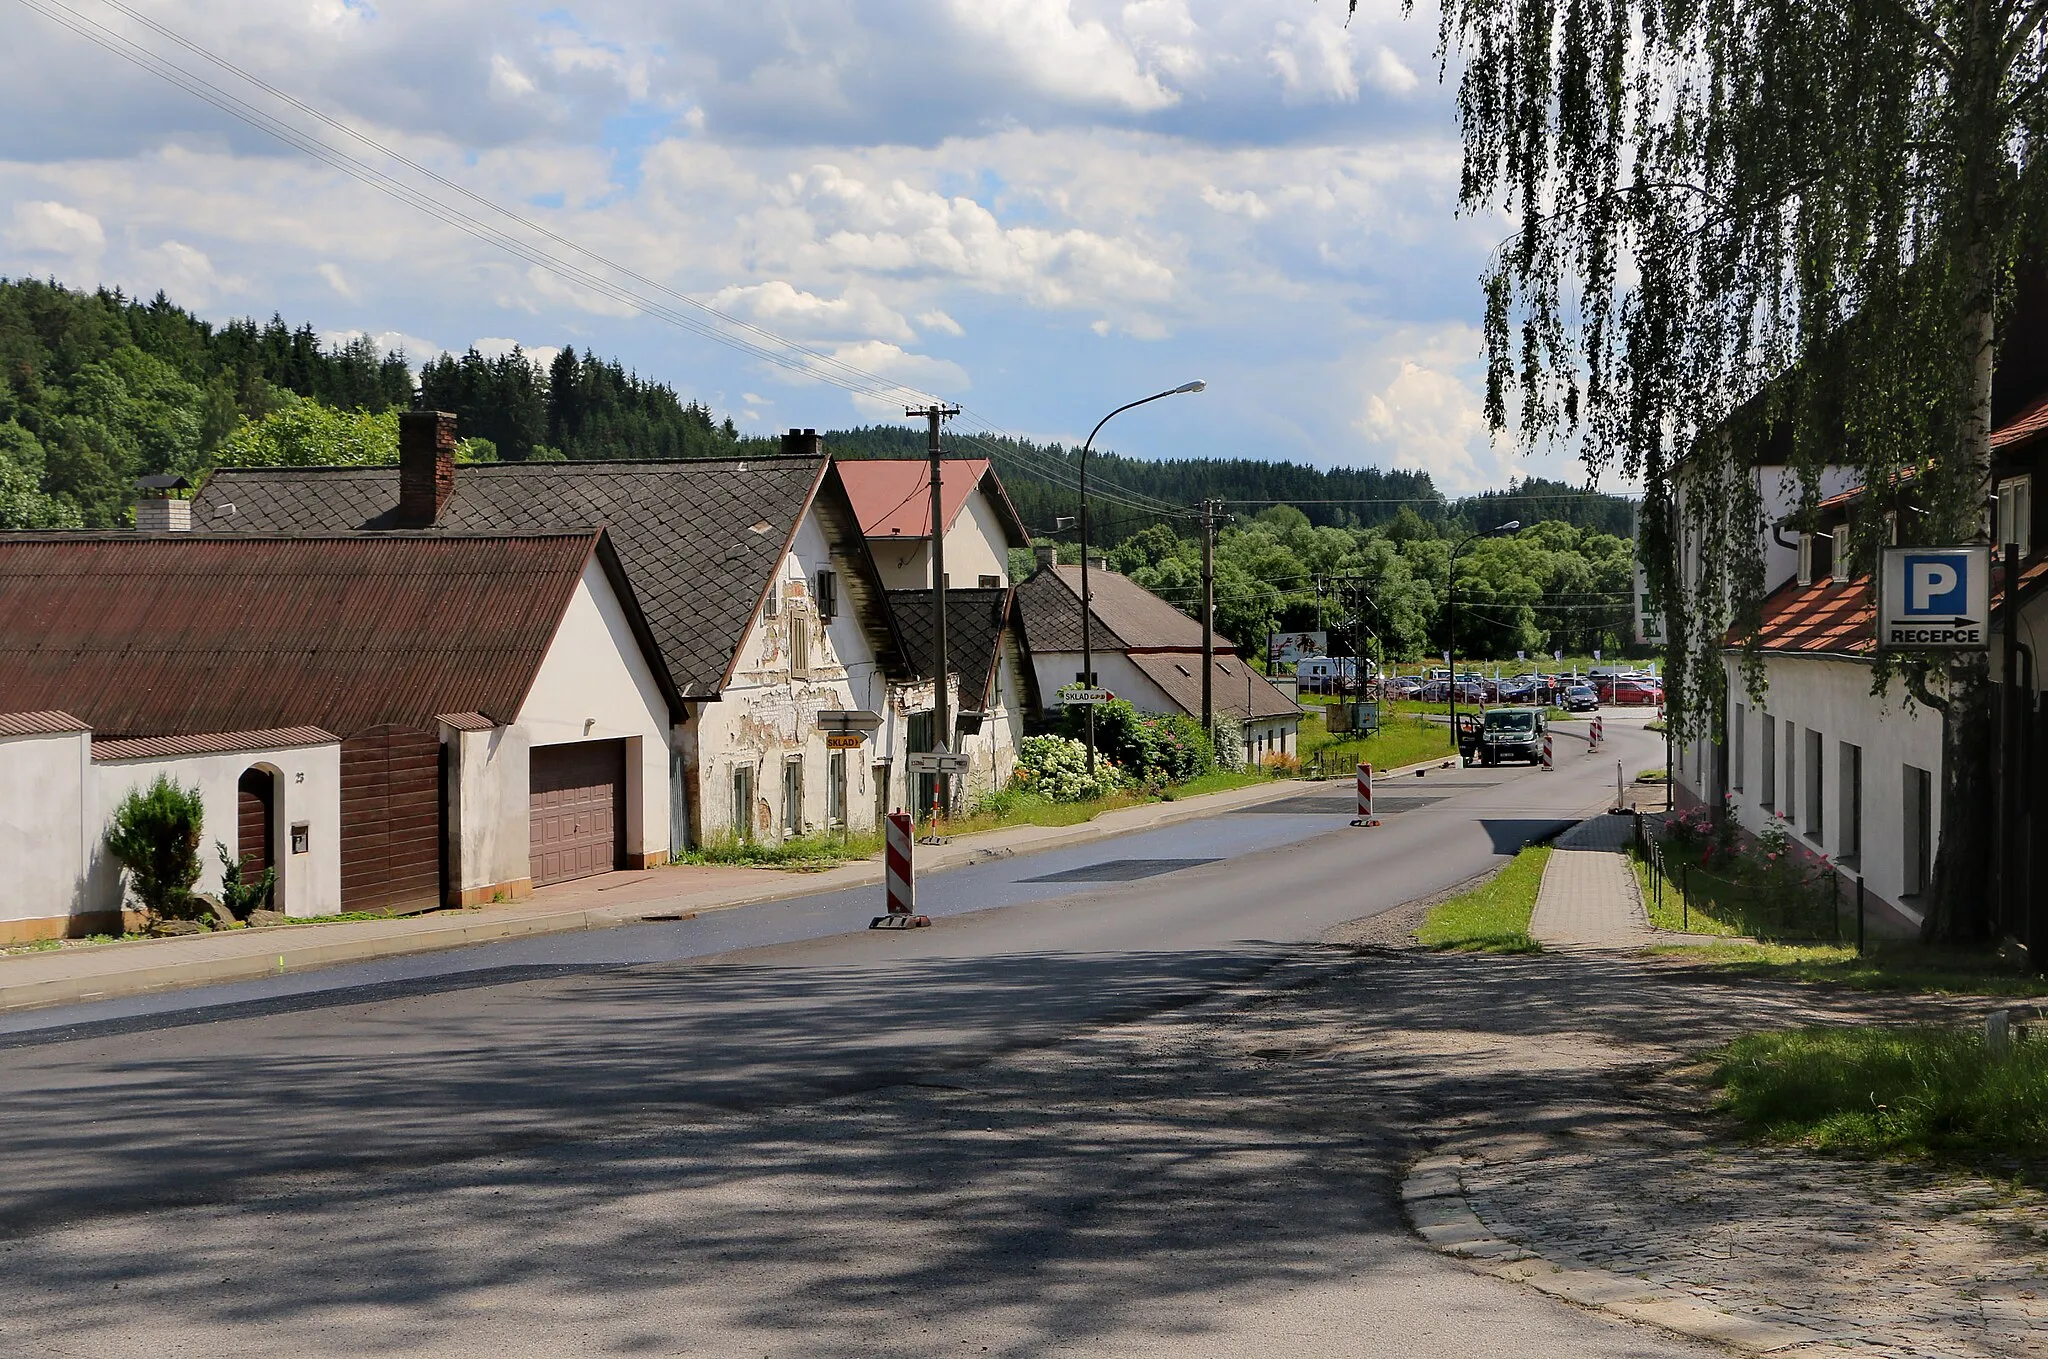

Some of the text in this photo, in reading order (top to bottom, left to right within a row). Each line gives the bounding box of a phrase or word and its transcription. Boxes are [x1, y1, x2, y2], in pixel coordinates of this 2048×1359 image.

[1912, 563, 1957, 609] P
[1891, 630, 1979, 643] RECEPCE
[828, 738, 854, 746] SKLAD
